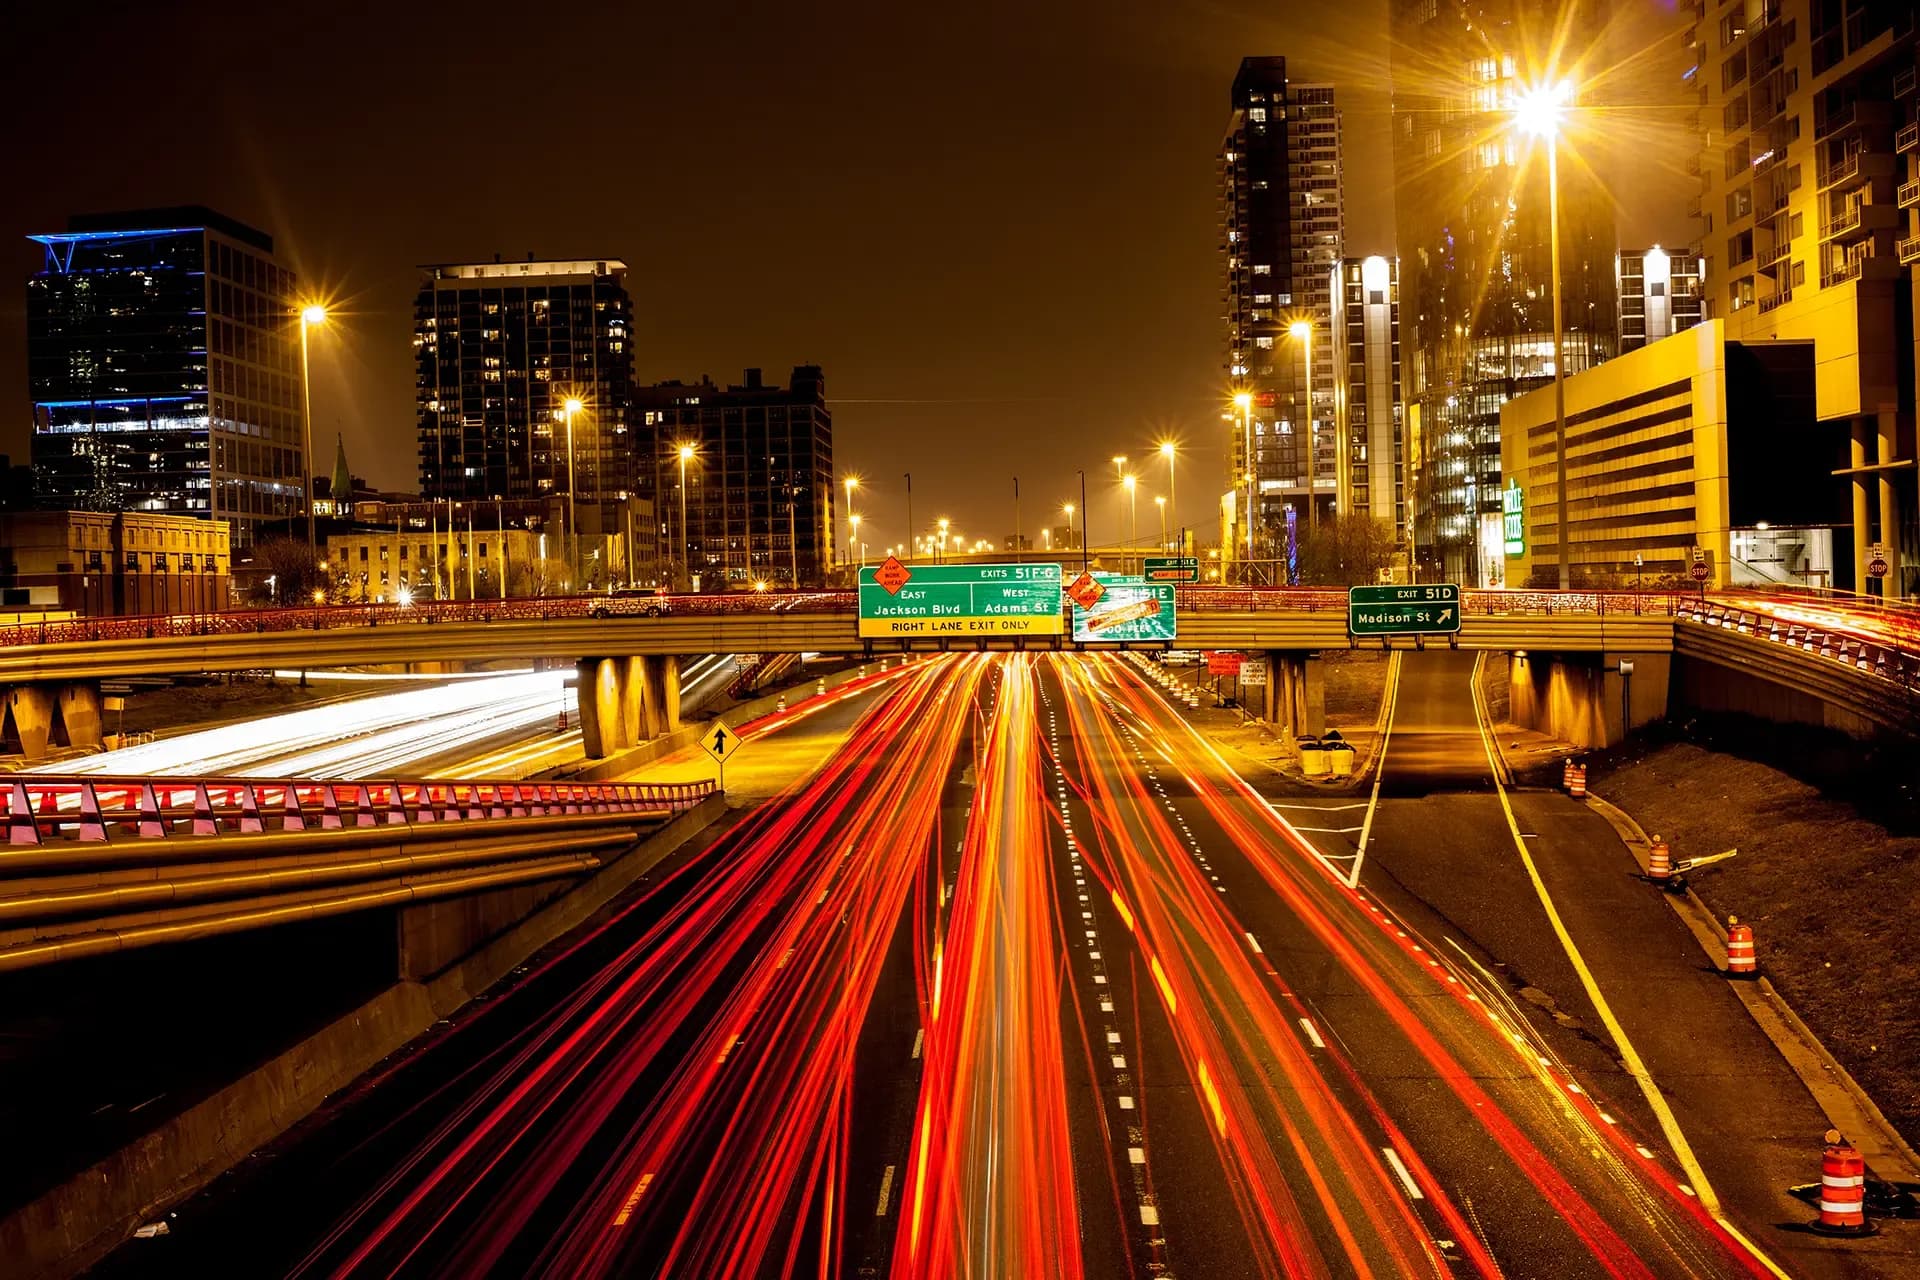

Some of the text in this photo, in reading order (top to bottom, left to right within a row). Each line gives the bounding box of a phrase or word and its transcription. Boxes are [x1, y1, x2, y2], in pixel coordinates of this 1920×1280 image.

[981, 569, 1008, 578] EXITS
[1692, 567, 1708, 576] STOP
[1870, 564, 1887, 573] STOP
[901, 590, 926, 599] EAST
[1003, 588, 1029, 598] WEST
[1397, 588, 1452, 599] EXIT 51D
[874, 604, 960, 615] Jackson Blvd
[985, 603, 1049, 614] Adams St
[1358, 612, 1430, 624] Madison St
[891, 621, 1030, 632] RIGHT LANE EXIT ONLY
